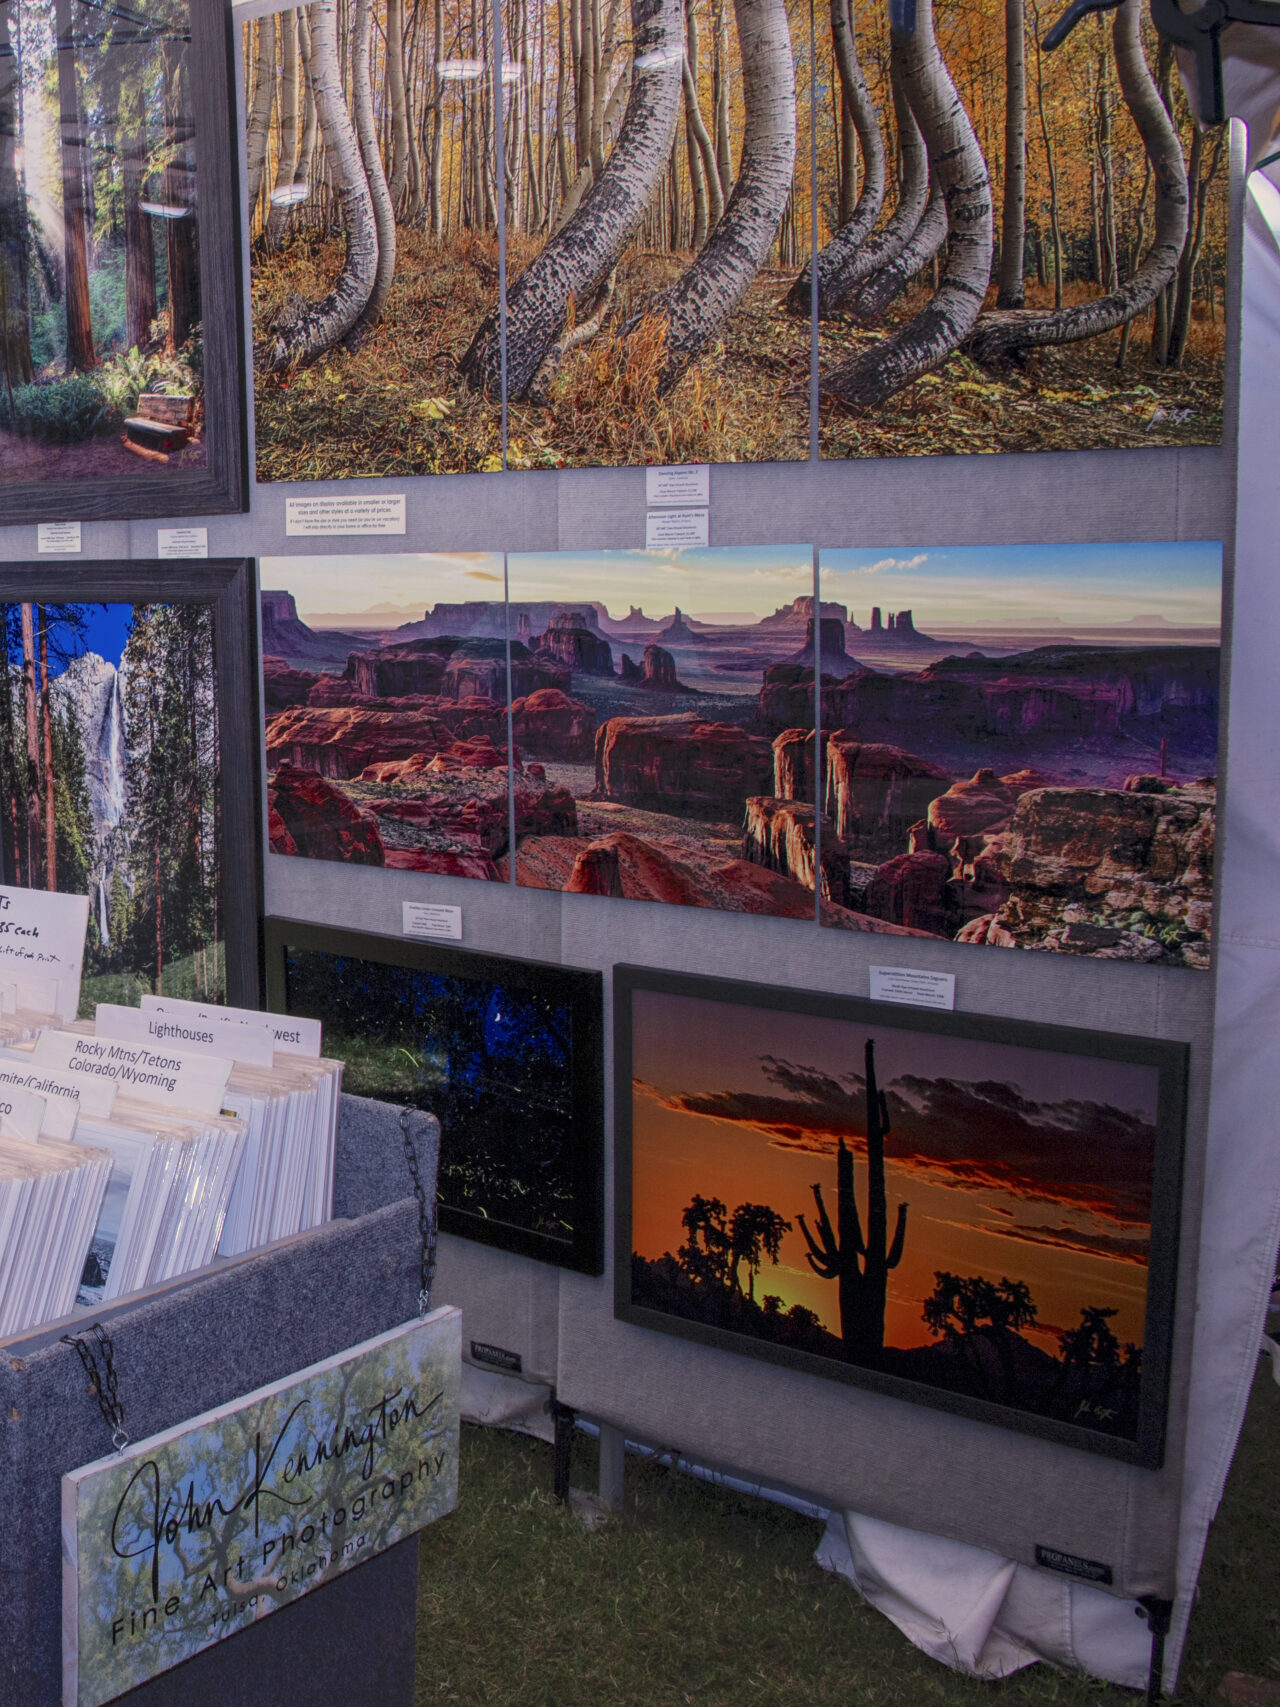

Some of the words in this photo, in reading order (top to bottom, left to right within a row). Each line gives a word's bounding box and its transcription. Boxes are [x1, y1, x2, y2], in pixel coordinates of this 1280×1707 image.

[14, 926, 40, 939] each
[148, 1020, 215, 1044] Lighthouses
[74, 1040, 108, 1060] Rocky
[107, 1045, 183, 1072] Mtns/Tetons
[68, 1057, 178, 1092] Colorado/Wyoming
[110, 1460, 240, 1604] John
[242, 1390, 444, 1539] Kennington
[110, 1594, 181, 1646] Fine
[198, 1556, 246, 1601] Art
[261, 1450, 447, 1566] Photography
[210, 1595, 266, 1629] Tulsa,
[274, 1533, 368, 1593] Oklahoma
